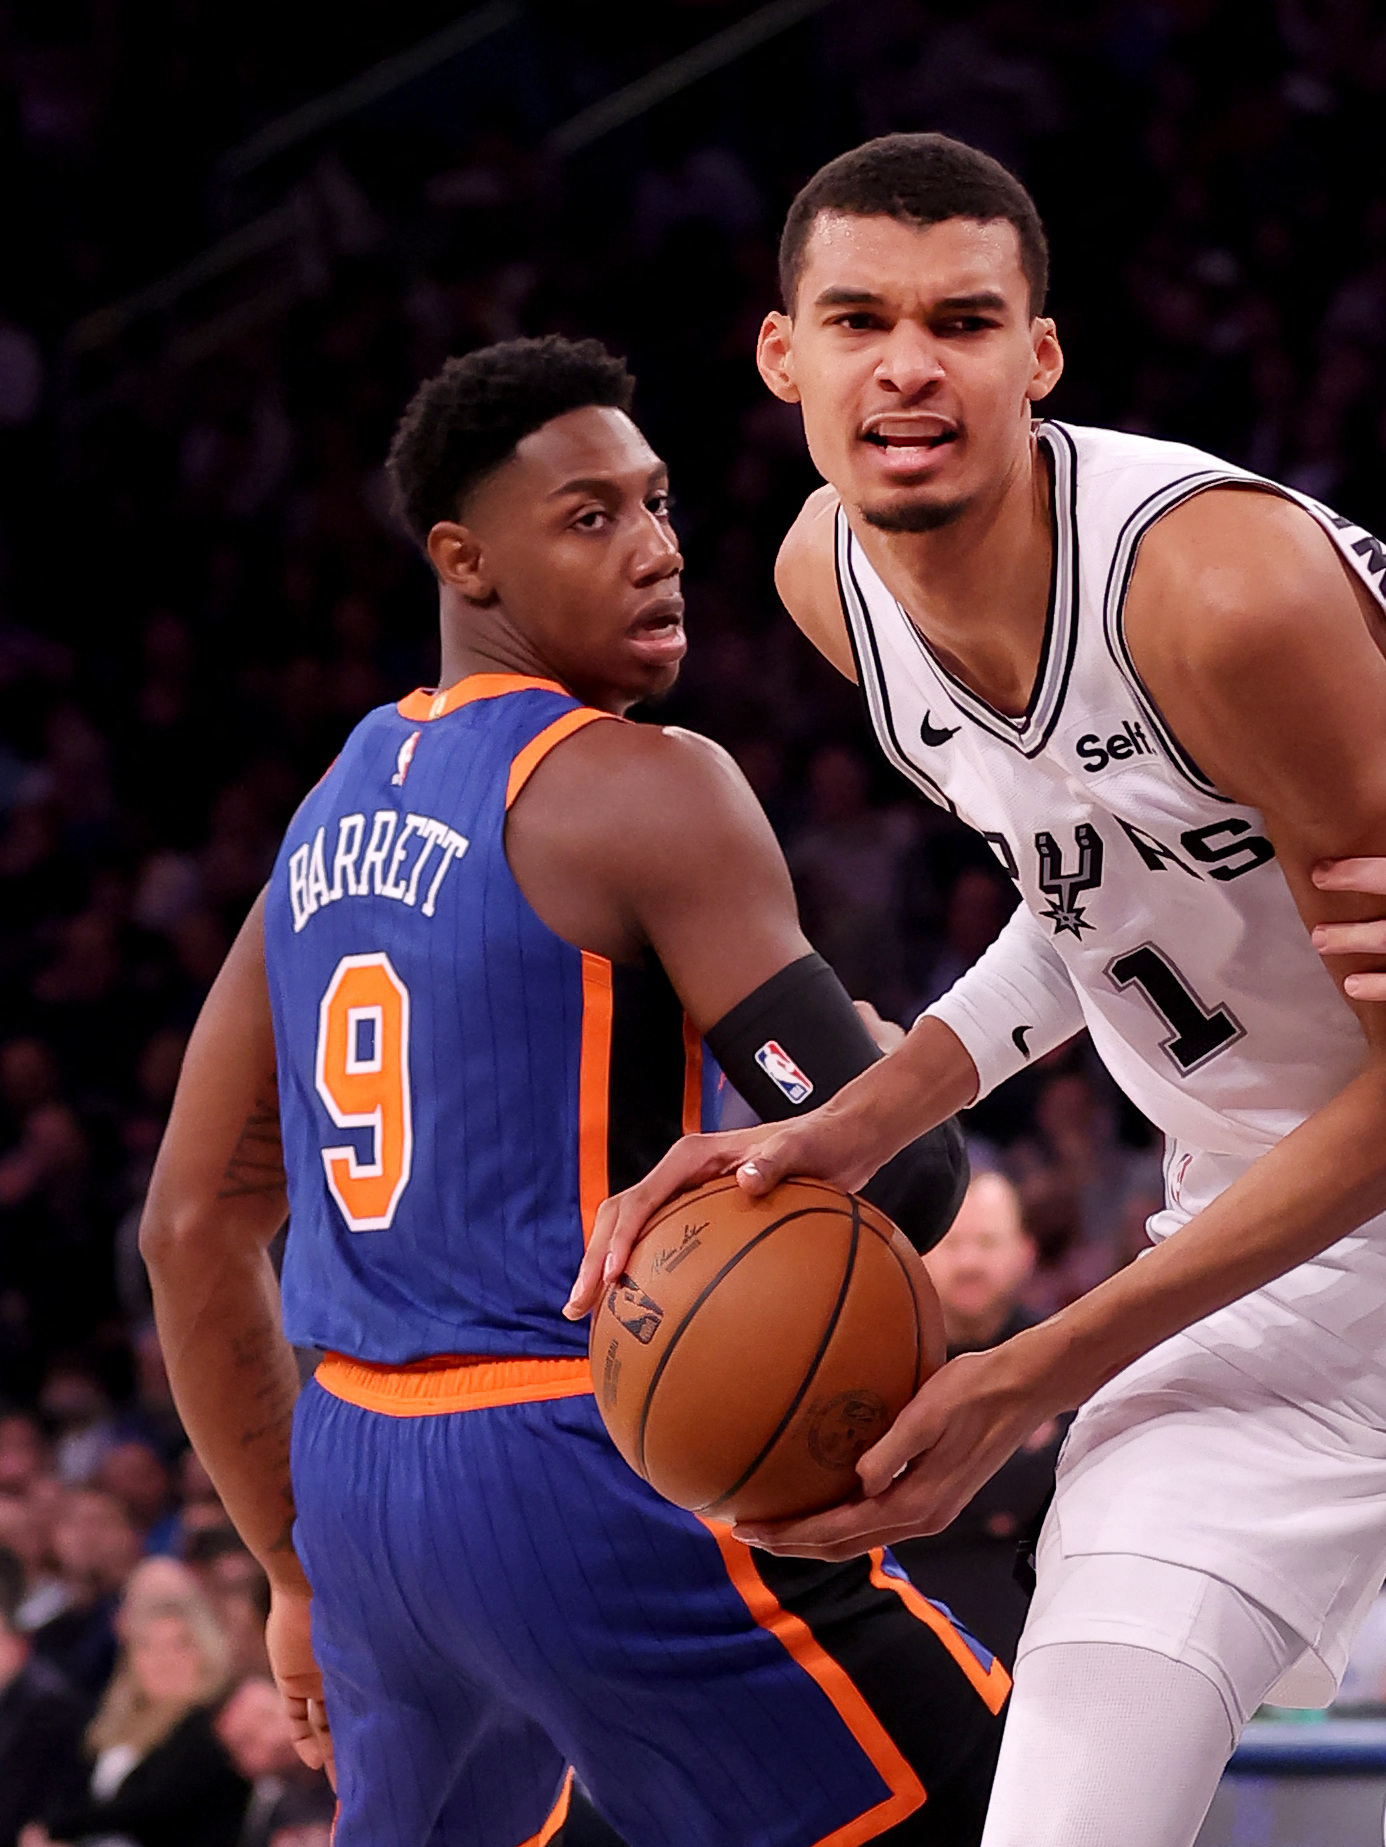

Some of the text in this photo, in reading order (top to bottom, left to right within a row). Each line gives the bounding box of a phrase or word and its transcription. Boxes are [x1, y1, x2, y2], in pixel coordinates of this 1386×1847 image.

[289, 810, 470, 934] BARRETT
[1102, 940, 1248, 1078] 1
[315, 950, 413, 1233] 9
